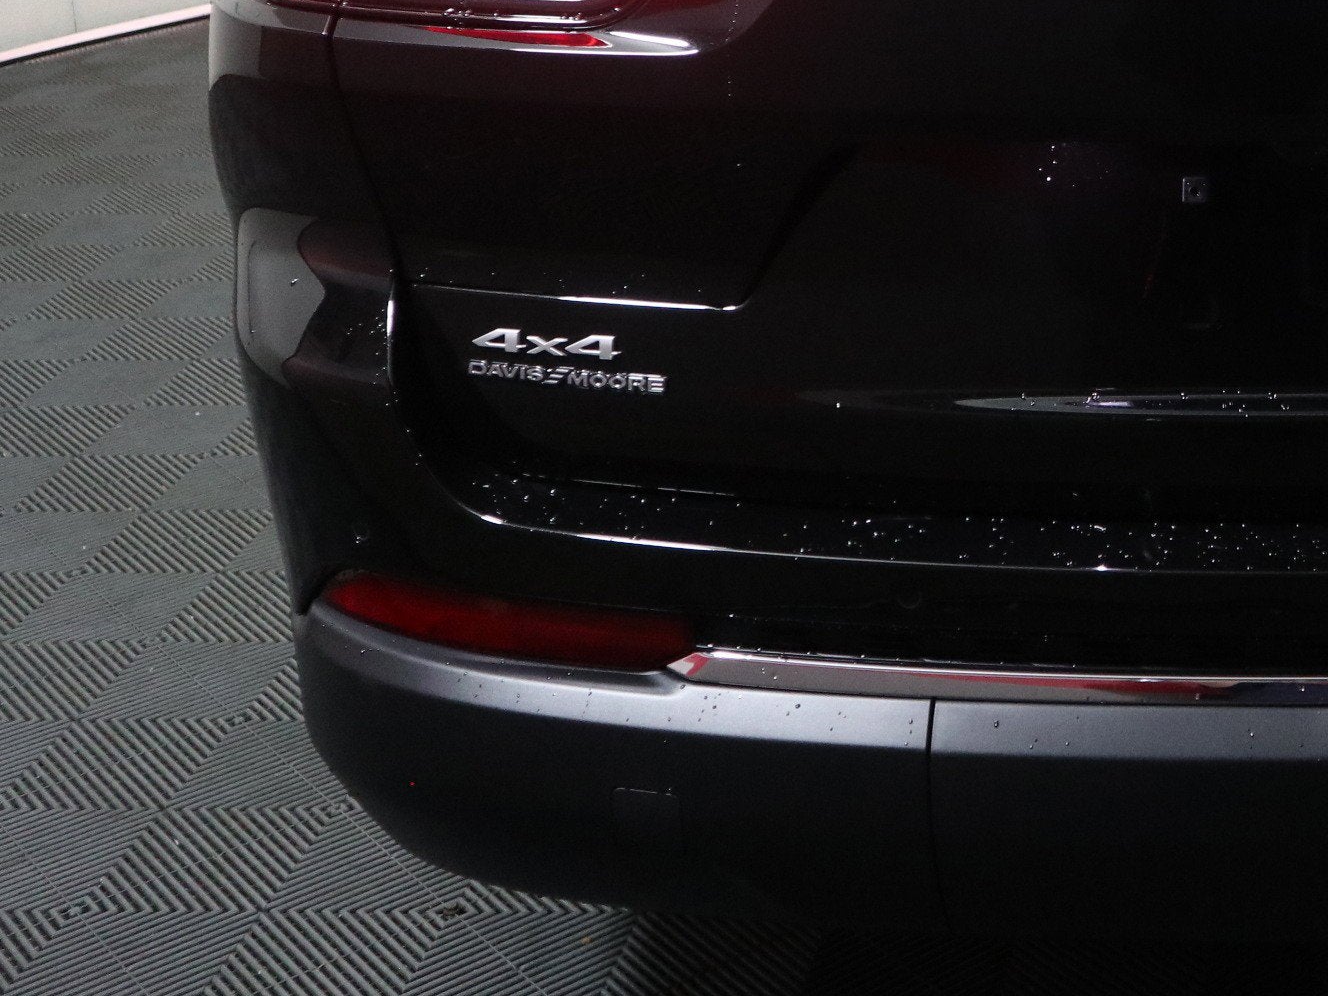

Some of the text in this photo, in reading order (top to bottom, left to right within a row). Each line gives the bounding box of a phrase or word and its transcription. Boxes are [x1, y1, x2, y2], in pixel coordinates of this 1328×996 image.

[471, 327, 623, 361] 4x4
[467, 359, 669, 394] DAVIS MOORE
